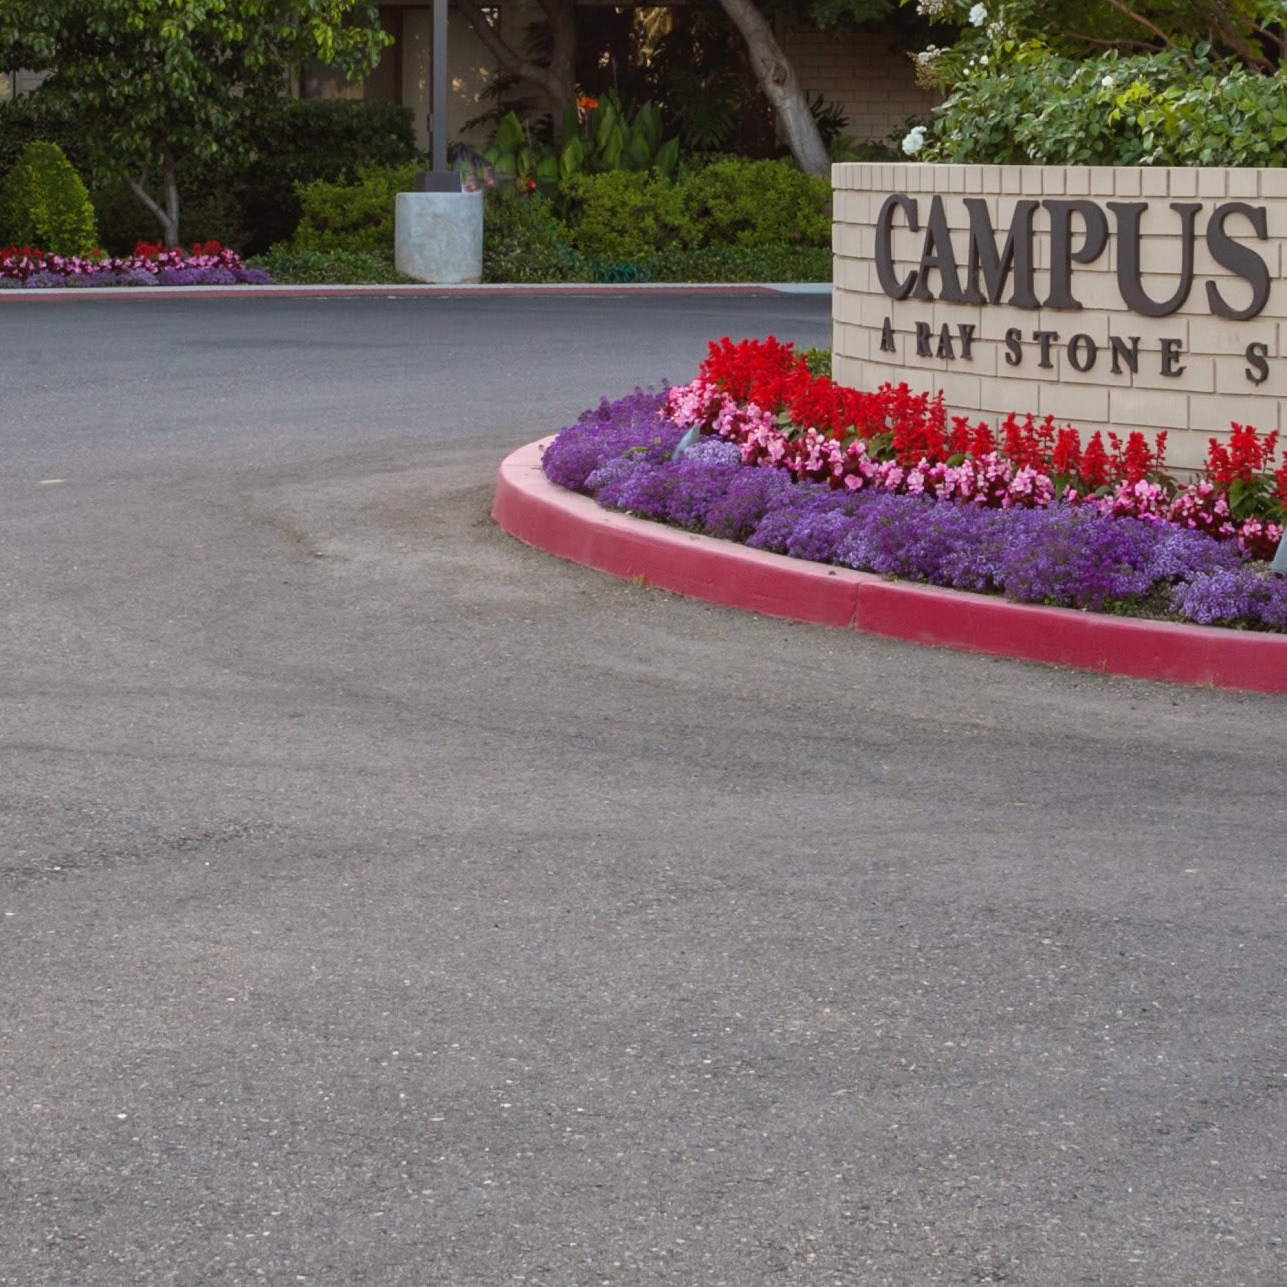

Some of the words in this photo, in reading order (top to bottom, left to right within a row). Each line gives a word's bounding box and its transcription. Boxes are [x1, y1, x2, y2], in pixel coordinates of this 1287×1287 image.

[874, 193, 1271, 322] CAMPUS
[879, 316, 896, 353] A
[914, 320, 976, 361] RAY
[1004, 327, 1187, 378] STONE
